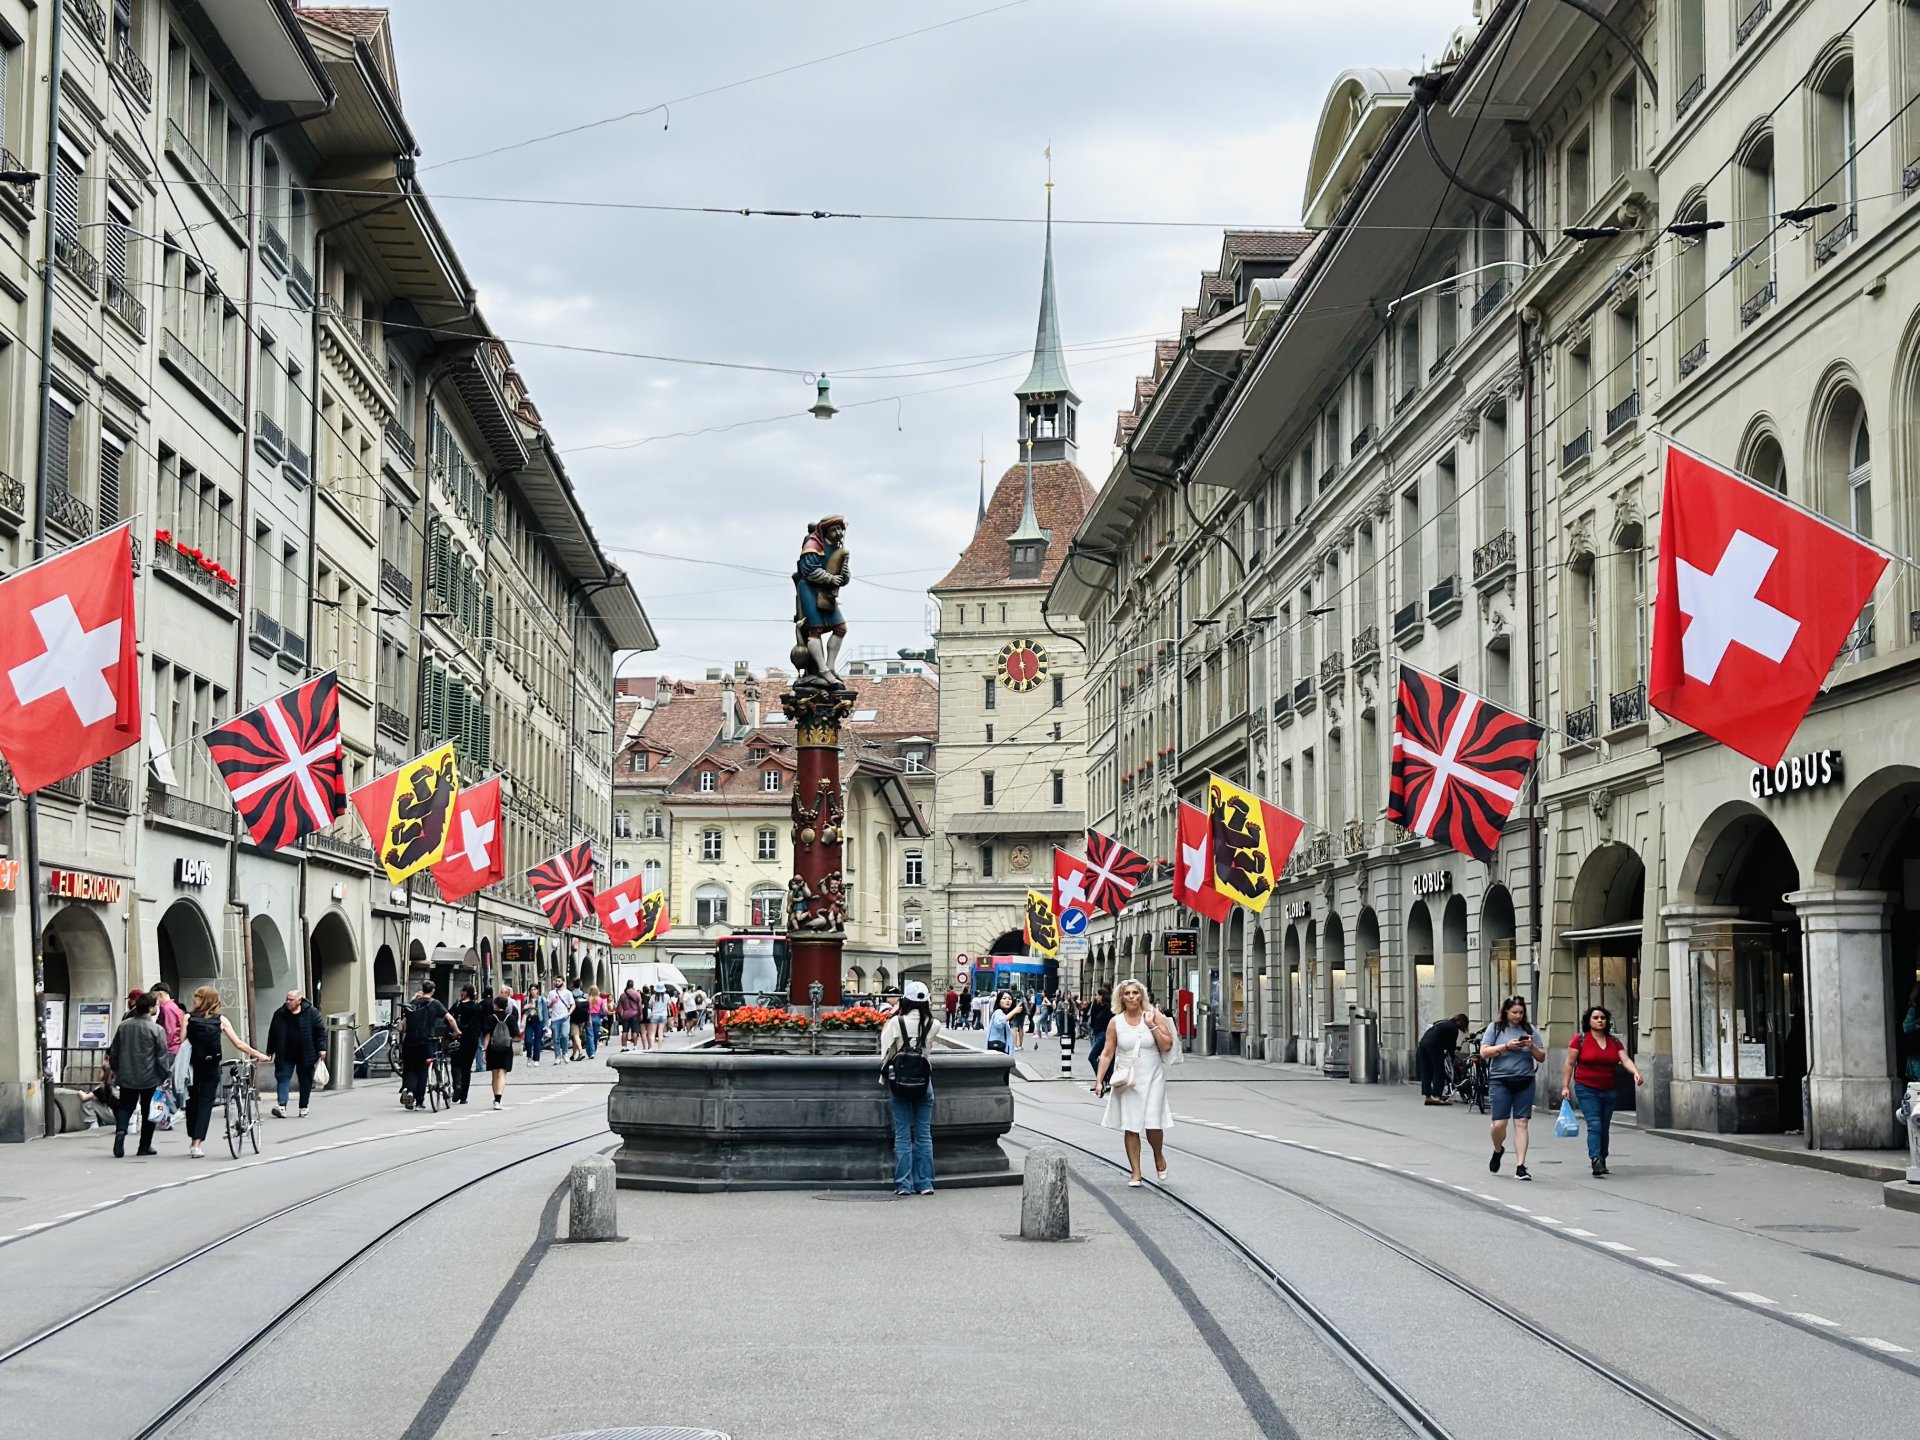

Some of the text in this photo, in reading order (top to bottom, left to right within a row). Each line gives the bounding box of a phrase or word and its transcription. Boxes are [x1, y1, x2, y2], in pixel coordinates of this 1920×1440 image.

[1749, 749, 1832, 799] GLOBUS
[59, 870, 121, 903] EL MEXICANO
[1412, 869, 1445, 896] GLOBUS
[1285, 900, 1306, 920] GLOBUS
